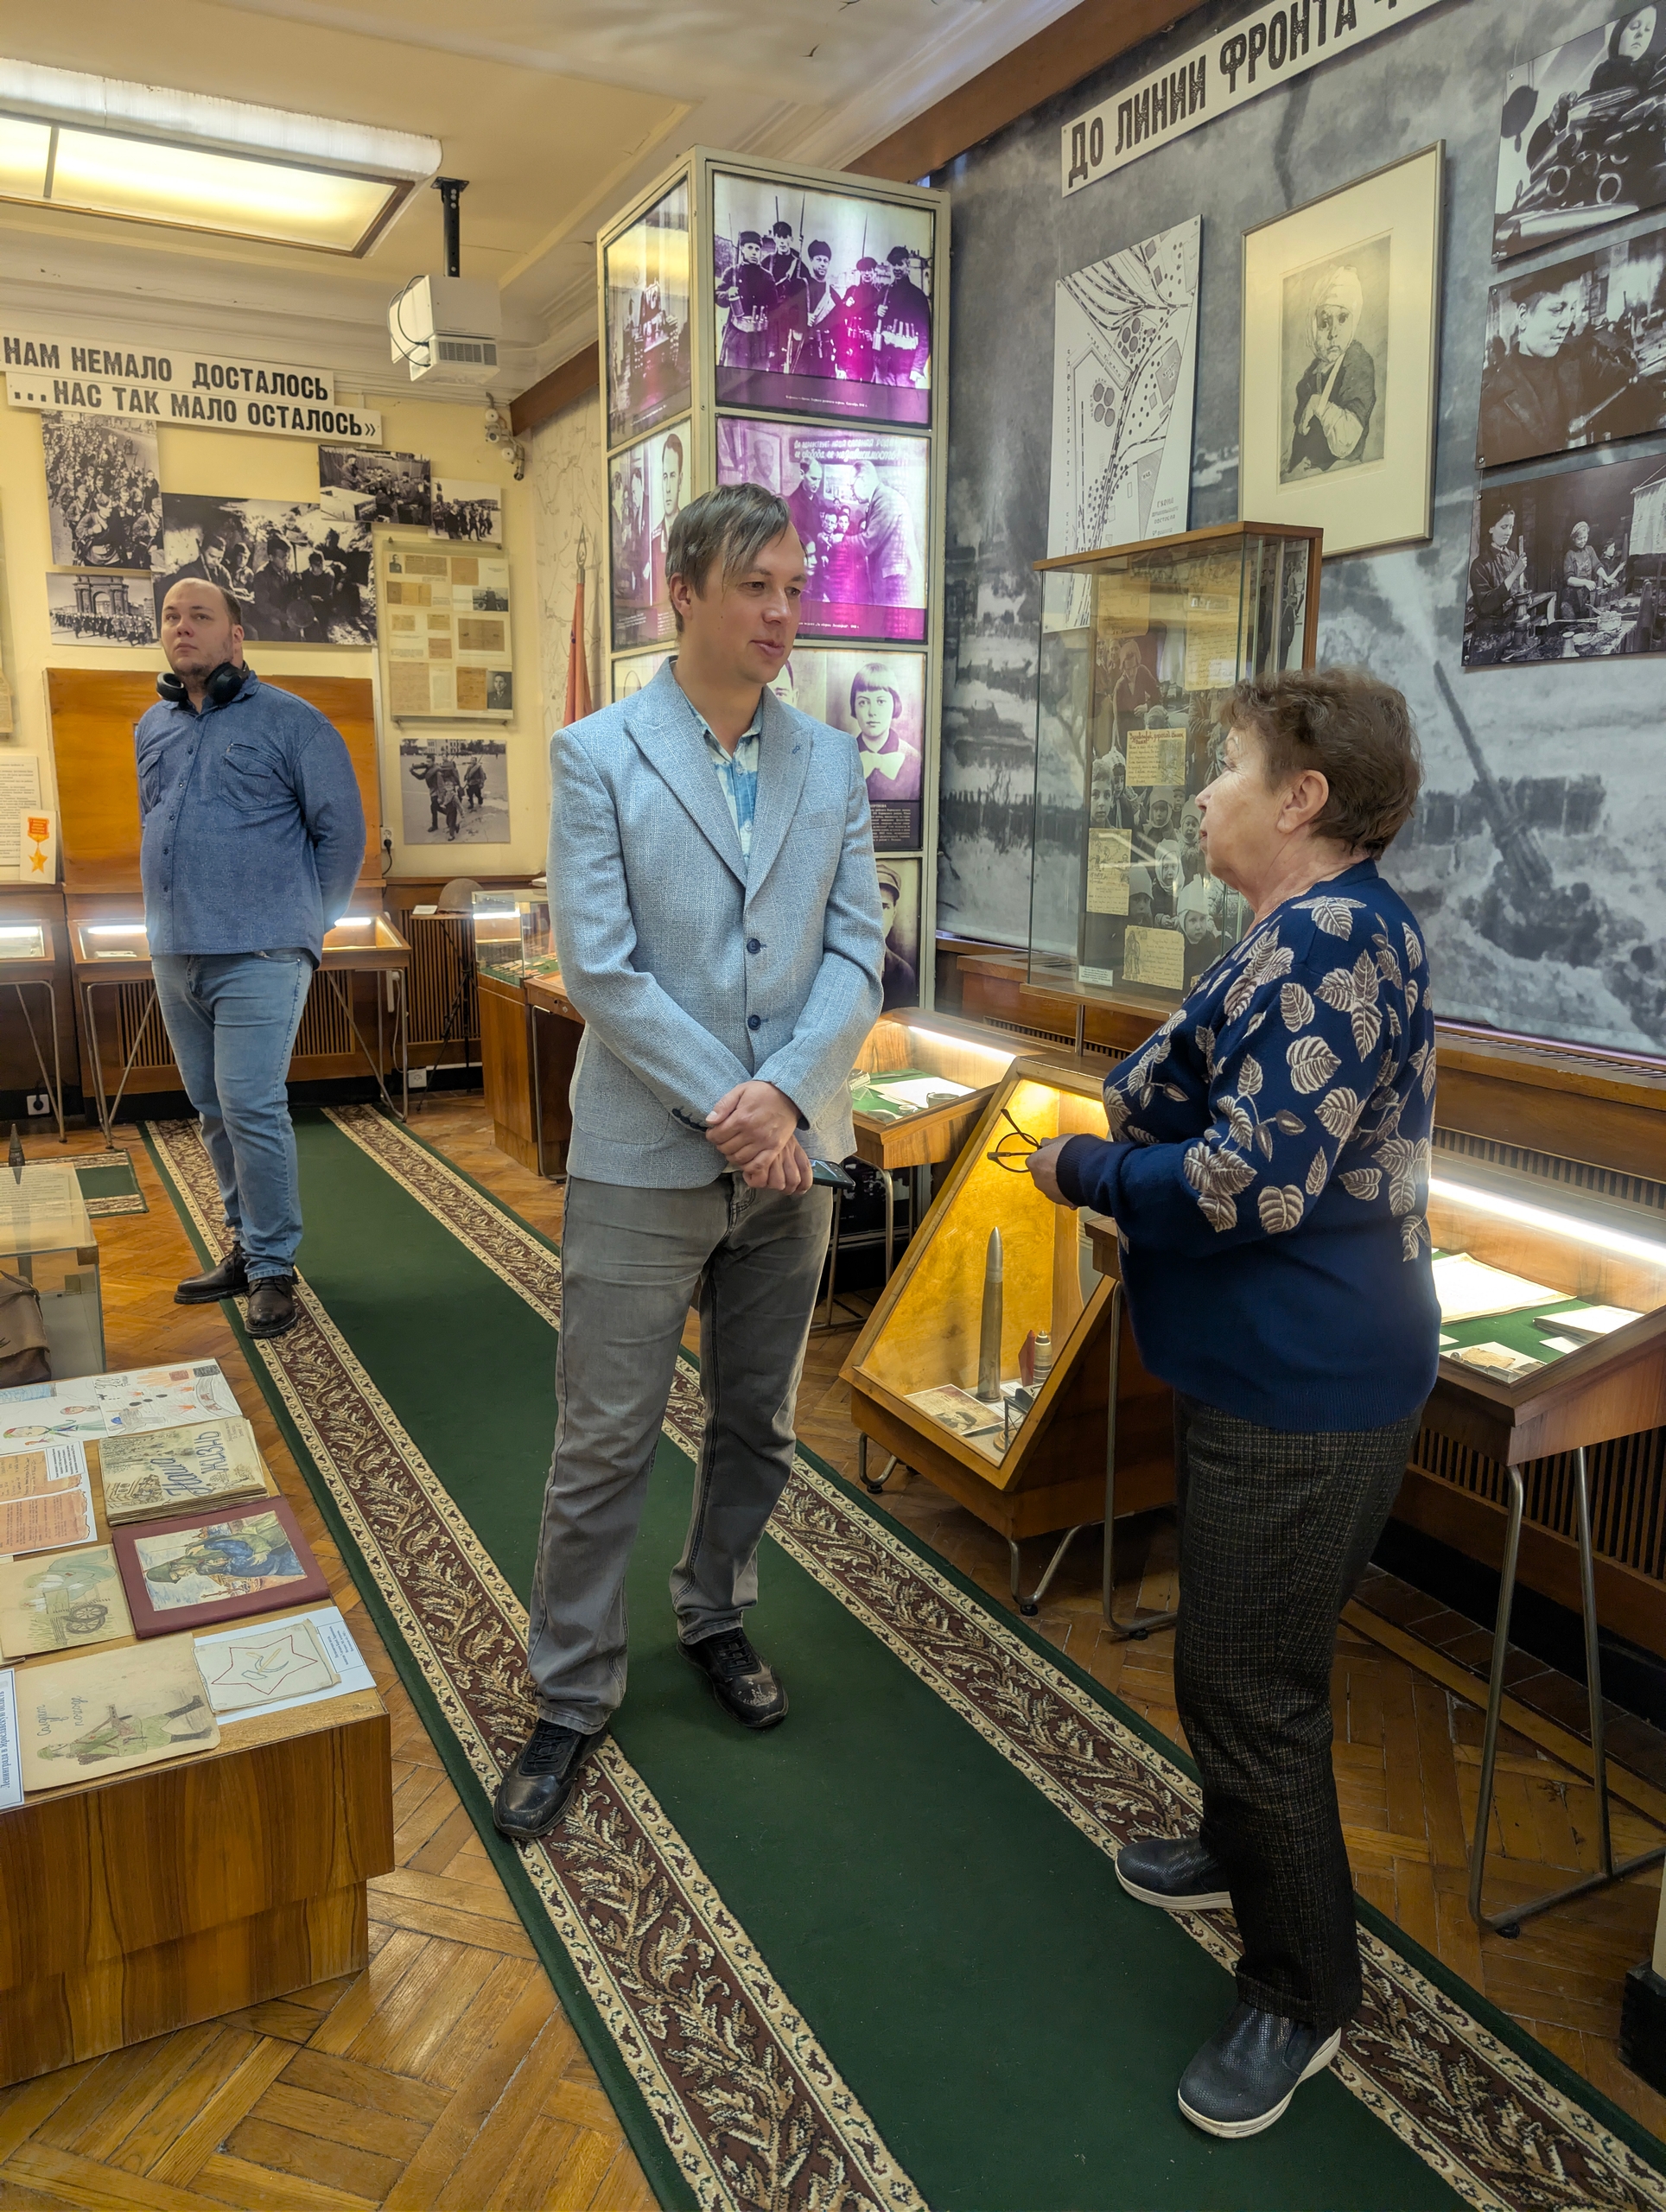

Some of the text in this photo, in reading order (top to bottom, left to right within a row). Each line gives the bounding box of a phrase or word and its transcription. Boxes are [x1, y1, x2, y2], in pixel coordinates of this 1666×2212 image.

[1068, 0, 1358, 188] ДО ЛИНИИ ФРОНТА
[3, 336, 328, 401] НАМ НЕМАЛО ДОСТАЛОСЬ
[112, 386, 160, 415] ТАК
[171, 393, 237, 423] МАЛО
[248, 403, 376, 436] ОСТАЛОСЬ»
[0, 1753, 11, 1788] Ленинграда
